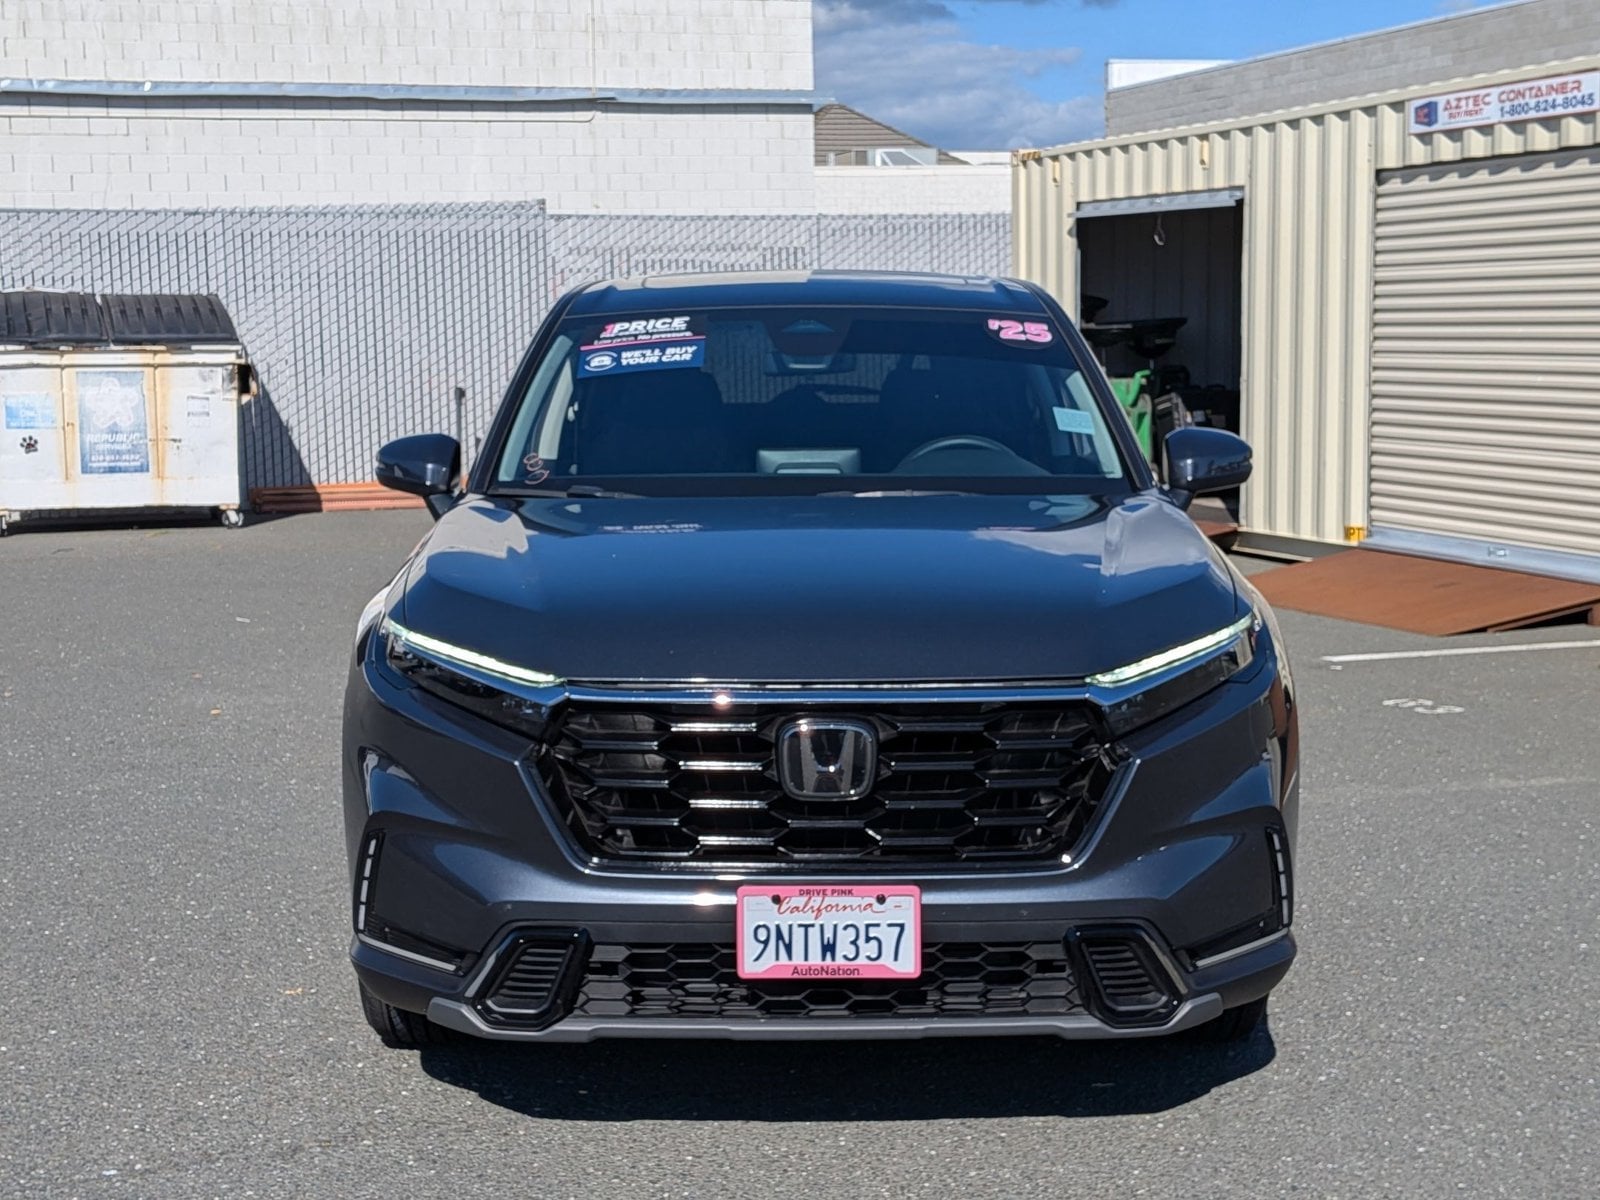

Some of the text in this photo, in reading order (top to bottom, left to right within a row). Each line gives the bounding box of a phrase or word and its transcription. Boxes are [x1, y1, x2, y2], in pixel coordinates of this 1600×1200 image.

[1443, 80, 1582, 113] AZTEC CONTAINER
[664, 345, 698, 355] BUY
[620, 355, 659, 366] YOUR
[661, 353, 693, 362] CAR
[798, 888, 854, 896] DRIVE PINK
[777, 896, 886, 920] California
[752, 922, 906, 962] 9NTW357
